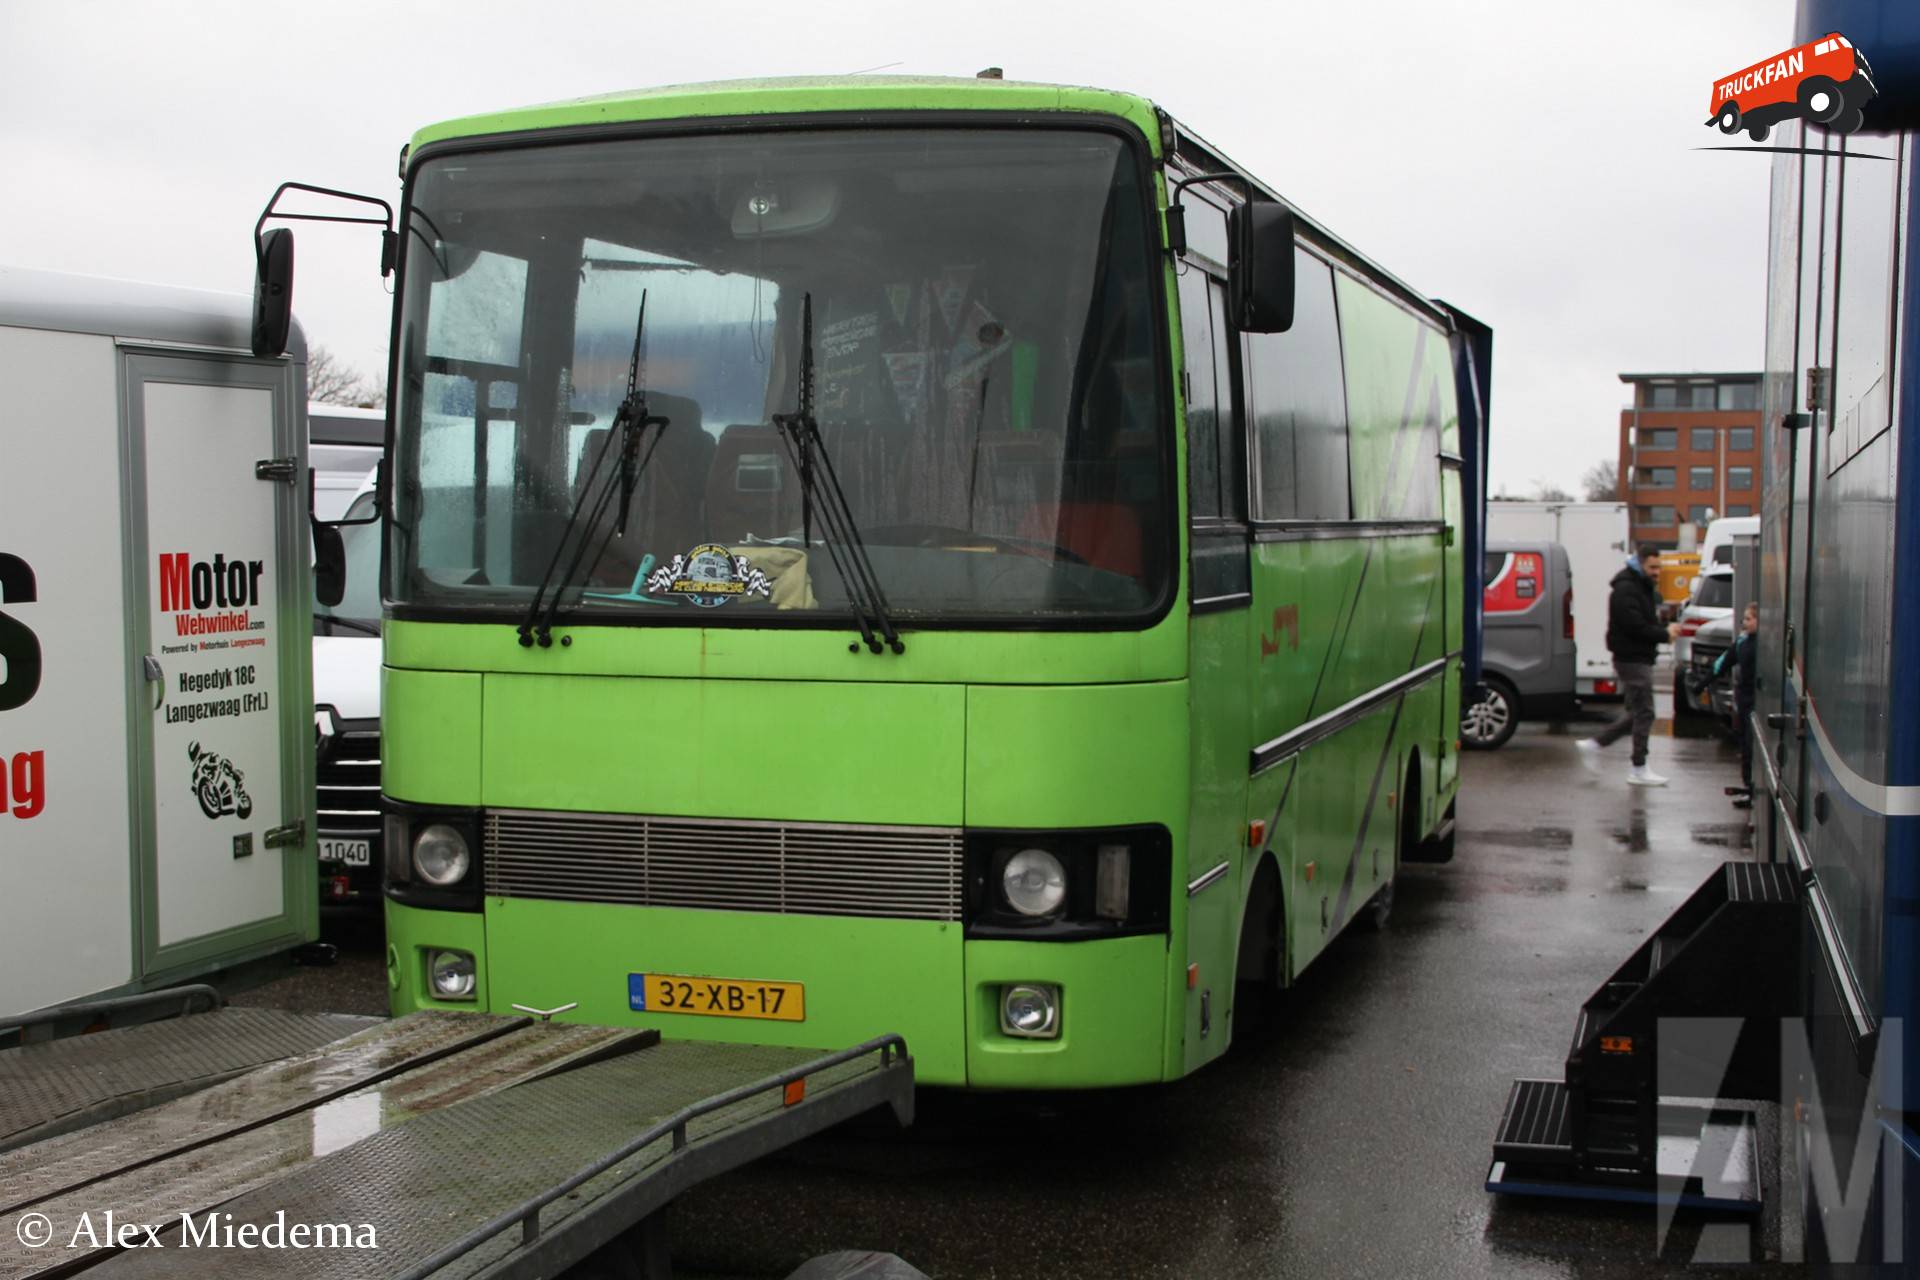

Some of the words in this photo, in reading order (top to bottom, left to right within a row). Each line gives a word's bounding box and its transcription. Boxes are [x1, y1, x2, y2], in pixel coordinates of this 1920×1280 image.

[159, 552, 264, 612] Motor
[176, 609, 265, 636] Webwinkel.com
[161, 643, 189, 655] Powered
[190, 642, 198, 654] by
[179, 667, 233, 693] Hegedyk
[234, 664, 256, 686] 18C
[166, 698, 241, 724] Langezwaag
[0, 751, 45, 819] g
[631, 995, 644, 1005] NL
[659, 980, 786, 1014] 32-XB-17
